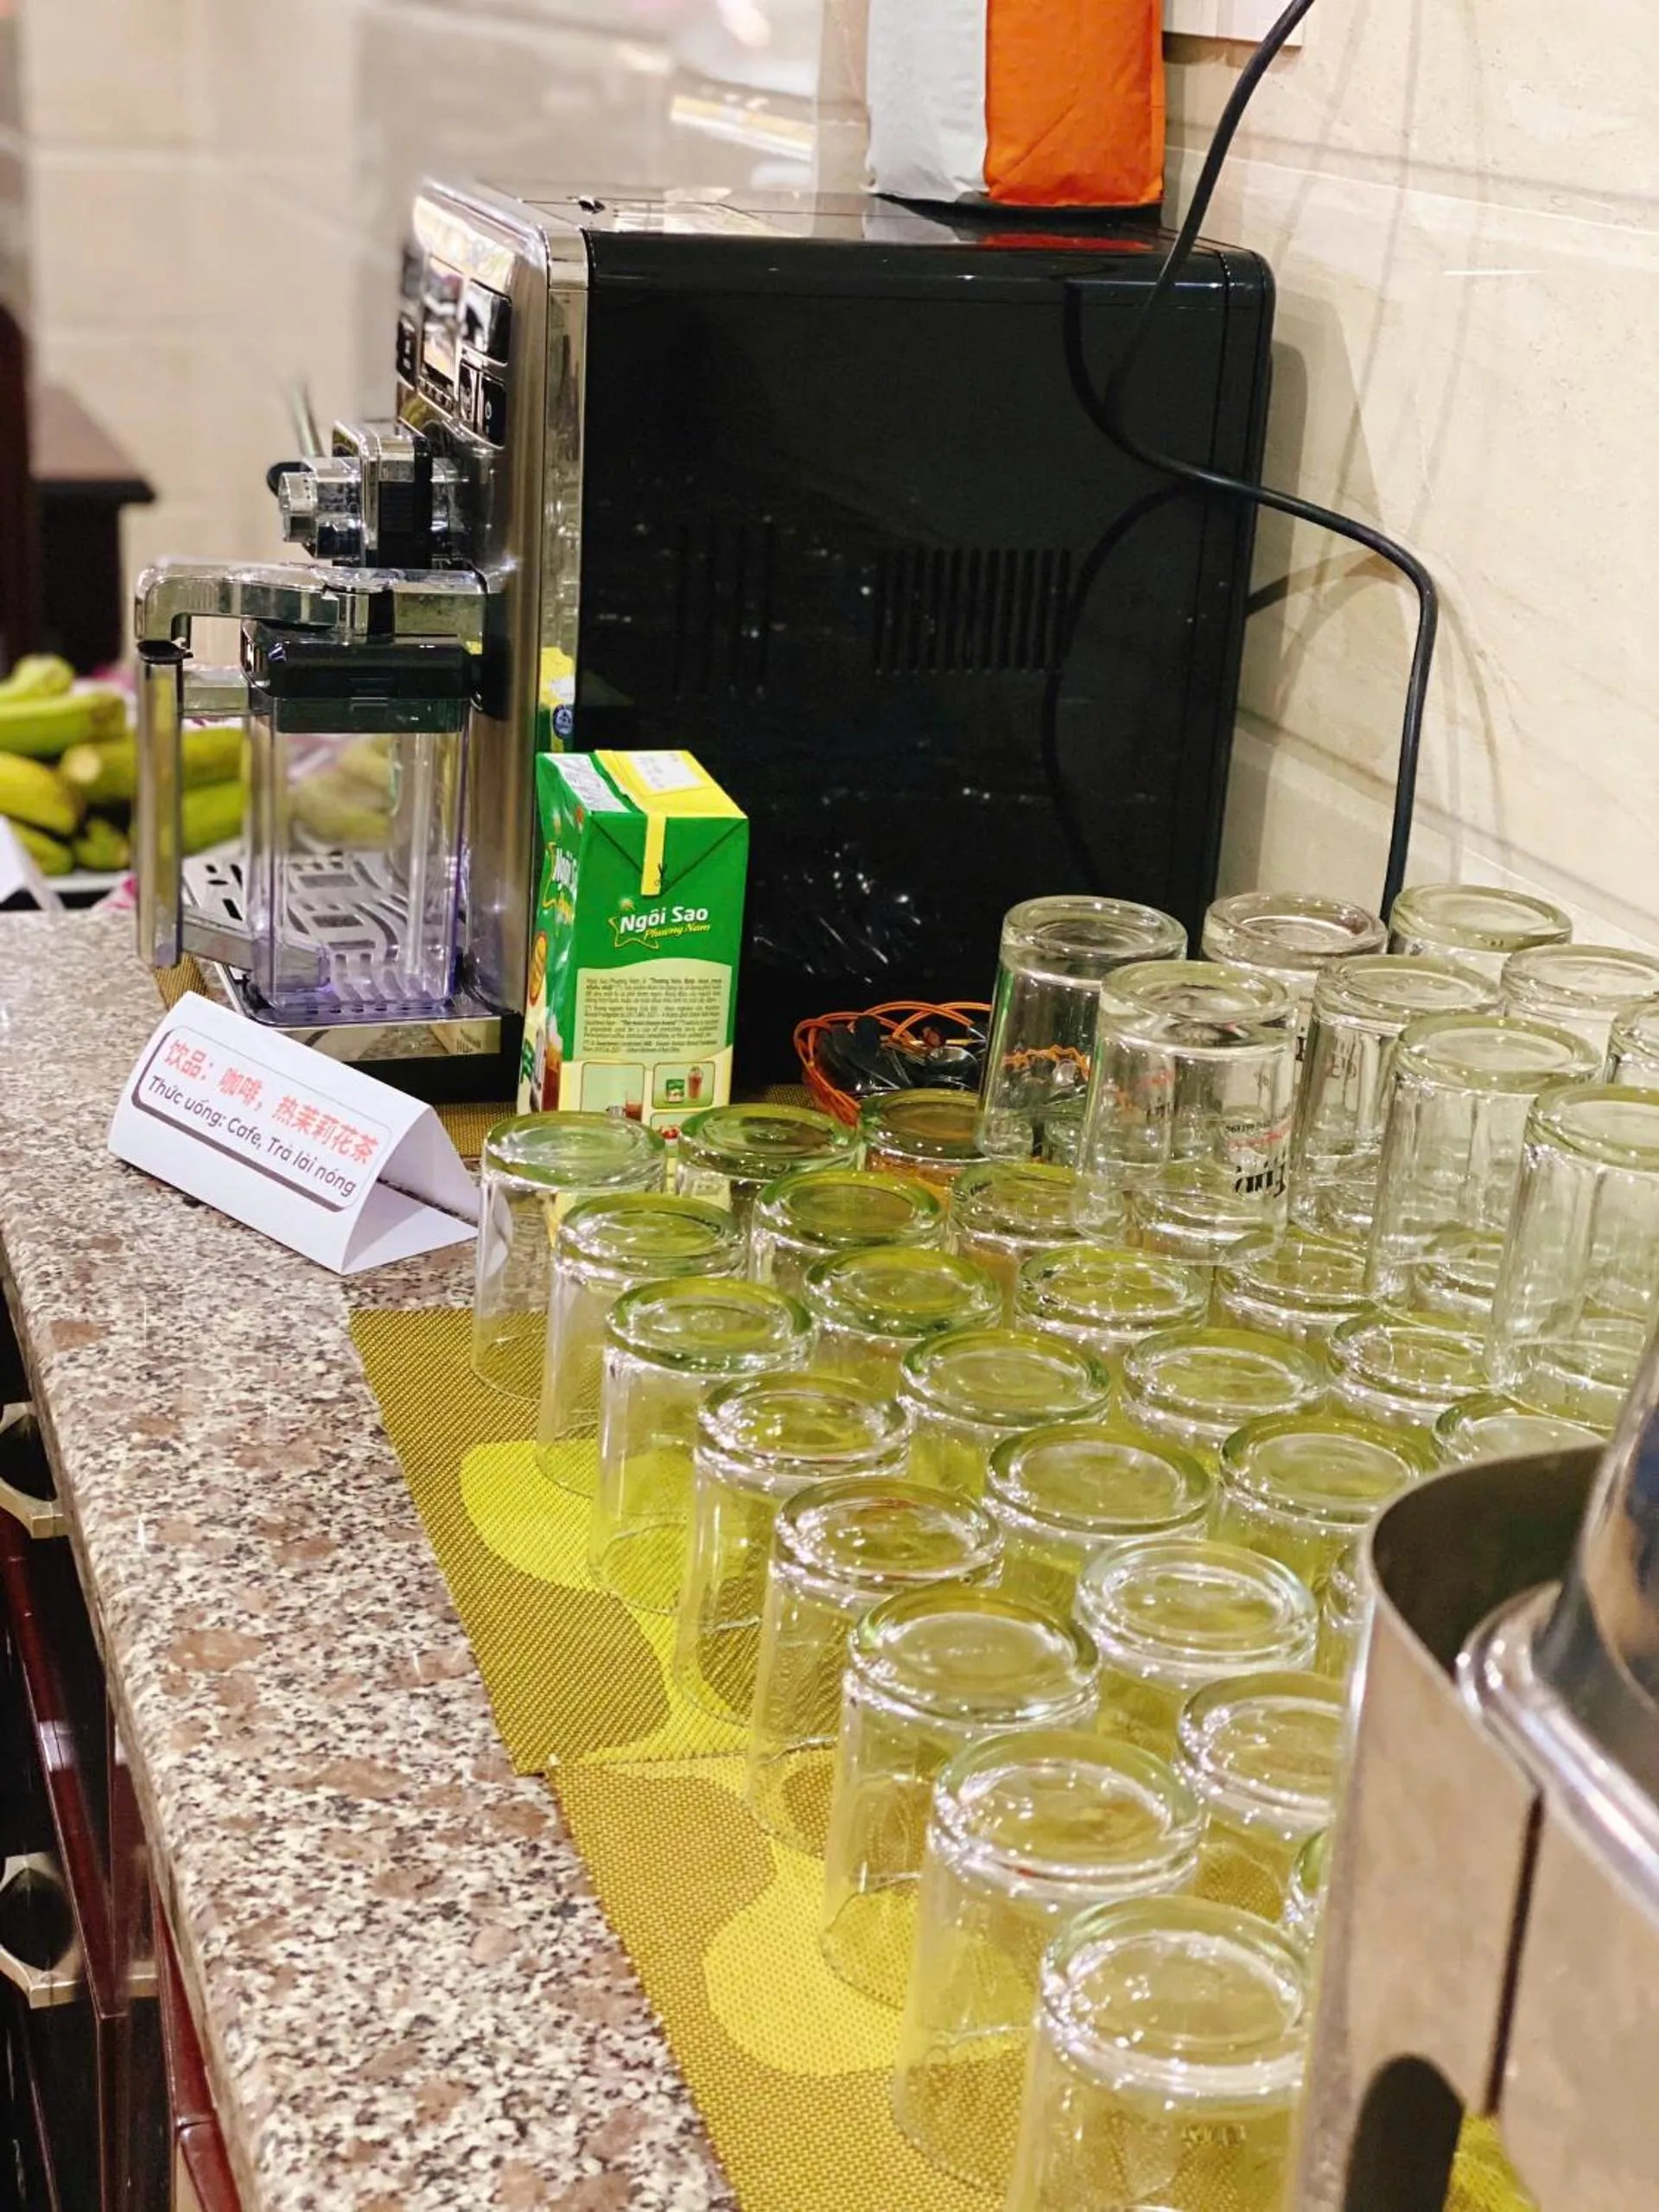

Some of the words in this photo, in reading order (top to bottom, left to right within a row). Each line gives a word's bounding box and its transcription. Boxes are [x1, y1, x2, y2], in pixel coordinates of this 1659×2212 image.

[620, 907, 666, 934] Ngôi
[671, 906, 709, 923] Sao
[148, 1075, 183, 1105] Thức
[184, 1098, 226, 1128] uống:
[227, 1117, 262, 1150] Cafe,
[314, 1166, 357, 1198] nóng
